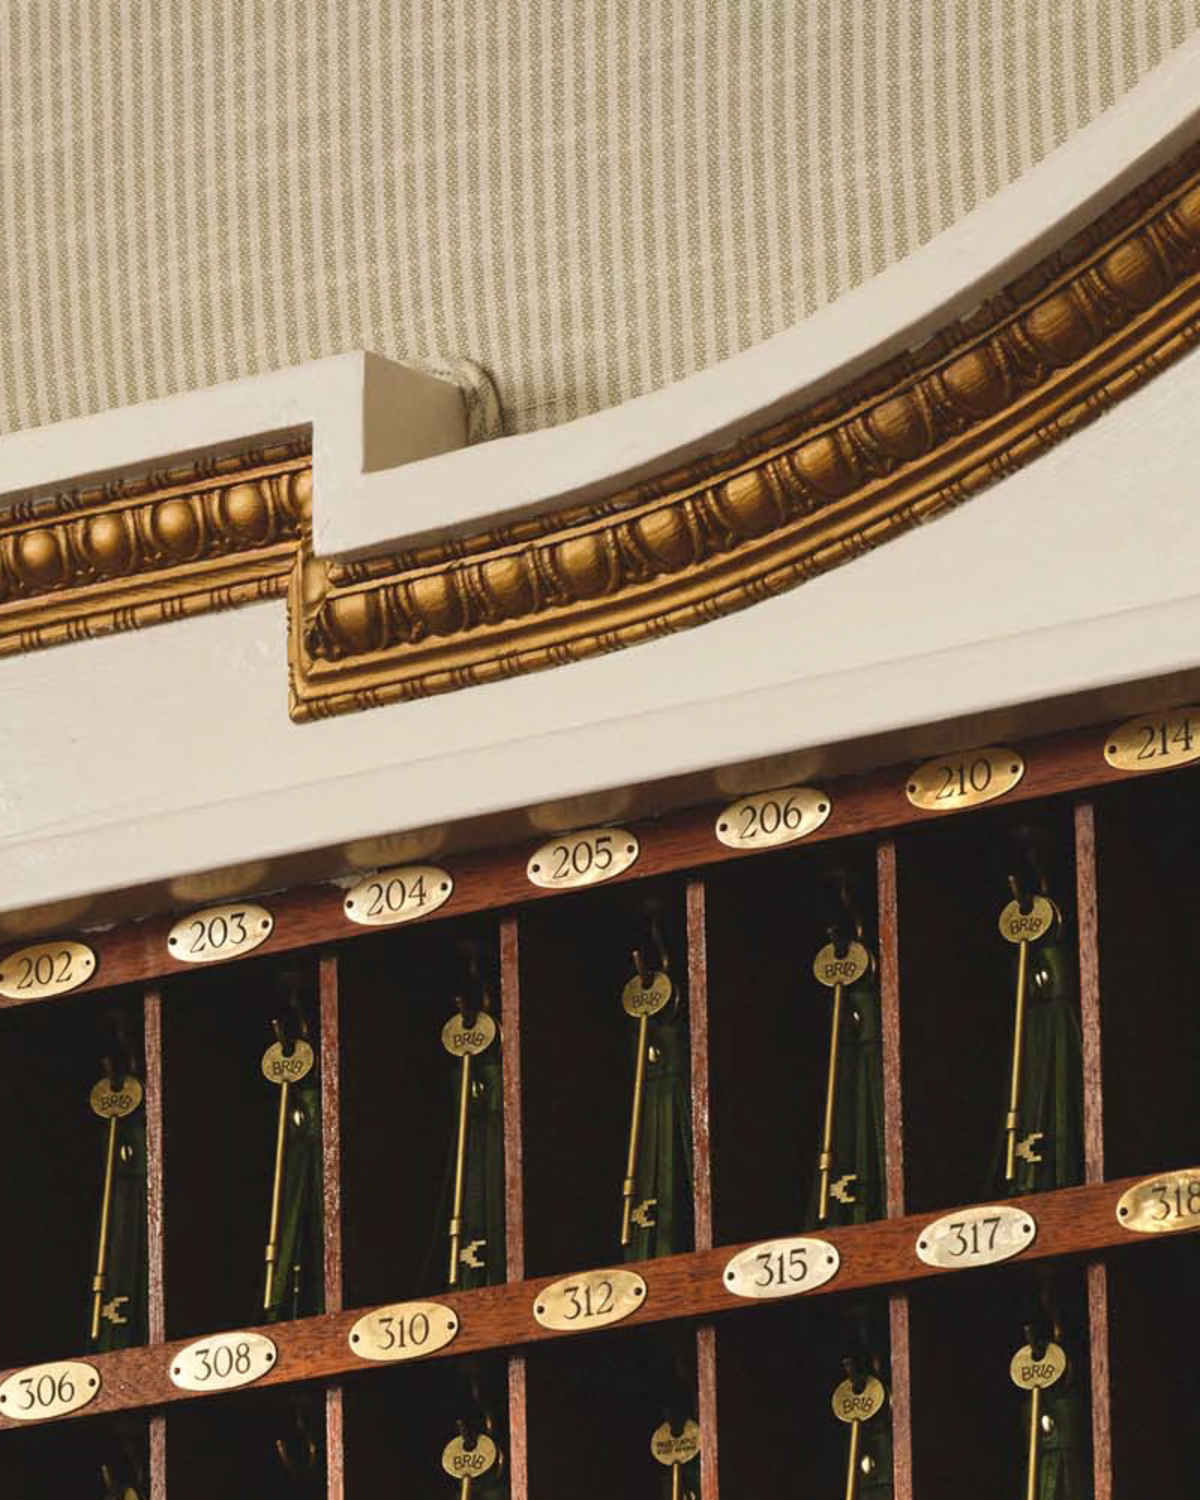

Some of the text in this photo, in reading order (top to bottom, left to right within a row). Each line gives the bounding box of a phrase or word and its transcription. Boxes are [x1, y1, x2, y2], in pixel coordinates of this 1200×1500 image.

[1137, 720, 1193, 760] 214
[936, 759, 991, 800] 210
[740, 796, 801, 839] 206
[552, 837, 612, 879] 205
[367, 876, 426, 916] 204
[190, 912, 247, 953] 203
[17, 951, 72, 989] 202
[1151, 1181, 1200, 1221] 318
[949, 1217, 1001, 1256] 317
[756, 1249, 807, 1286] 315
[563, 1282, 614, 1320] 312
[379, 1313, 429, 1350] 310
[194, 1343, 251, 1380] 308
[19, 1371, 75, 1410] 306
